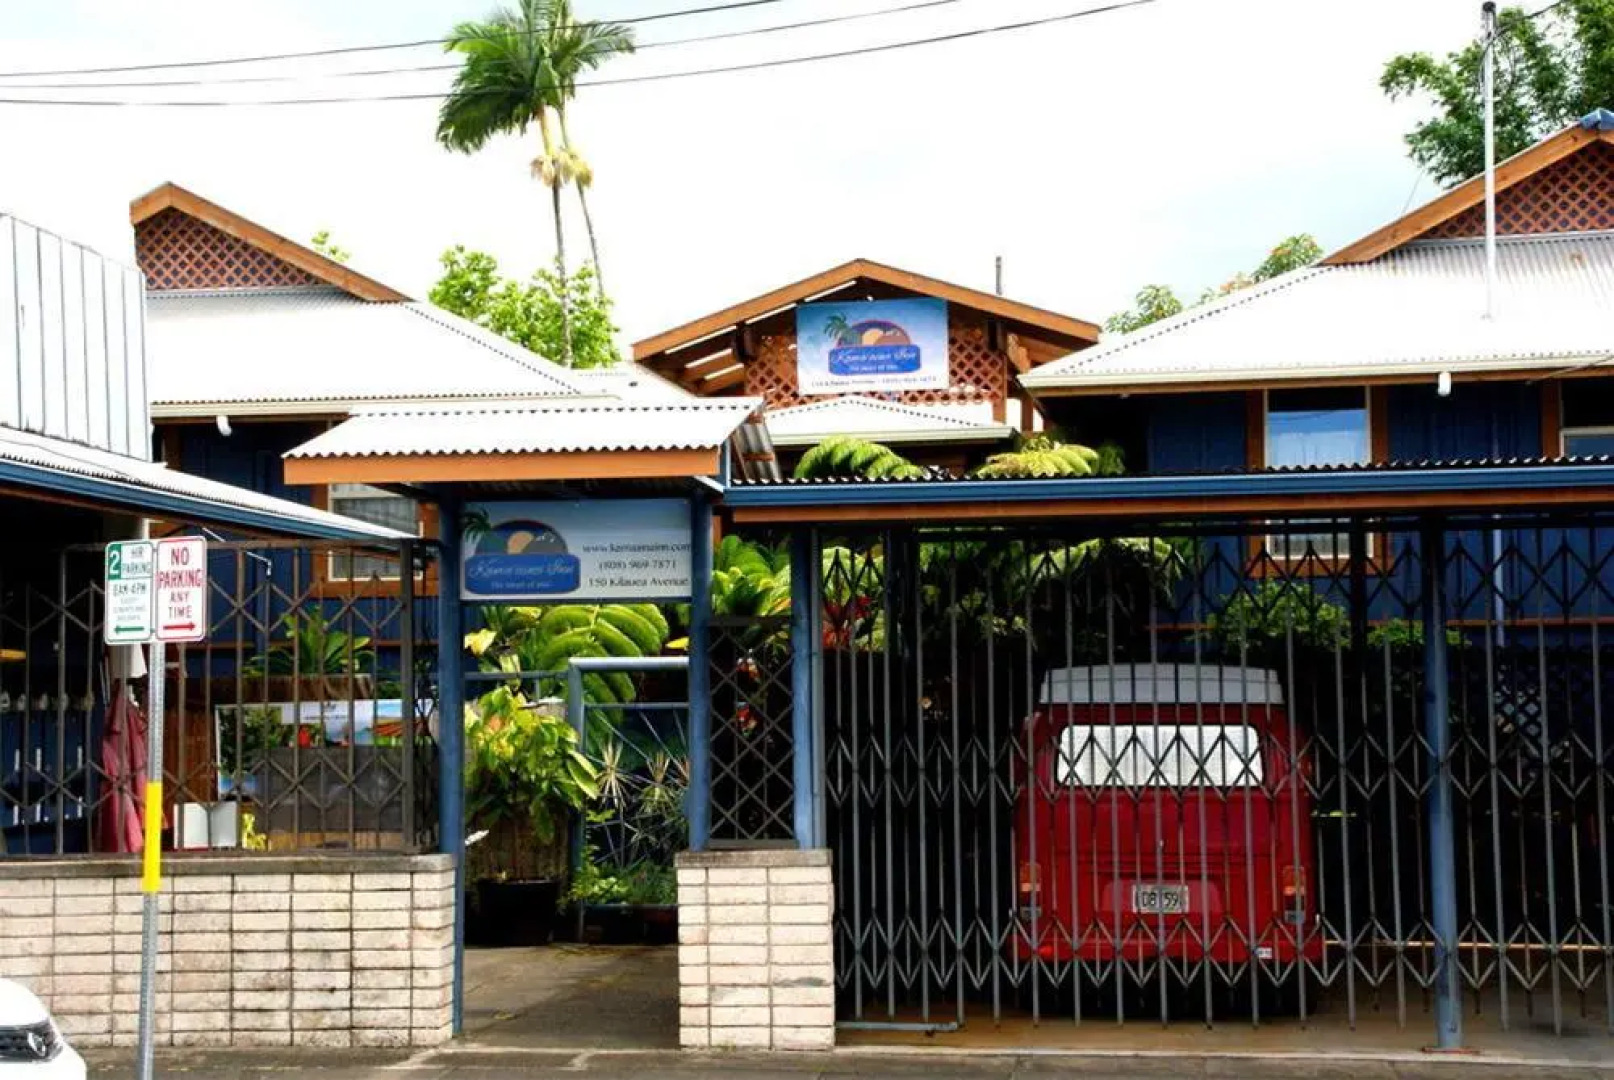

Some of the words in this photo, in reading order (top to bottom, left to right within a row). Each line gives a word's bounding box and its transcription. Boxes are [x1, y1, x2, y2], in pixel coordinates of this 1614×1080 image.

[109, 550, 120, 575] 2
[170, 546, 190, 566] NO
[122, 562, 153, 576] PARKING
[156, 568, 204, 589] PARKING
[650, 577, 689, 587] Avenue
[170, 590, 189, 603] ANY
[168, 605, 193, 619] TIME
